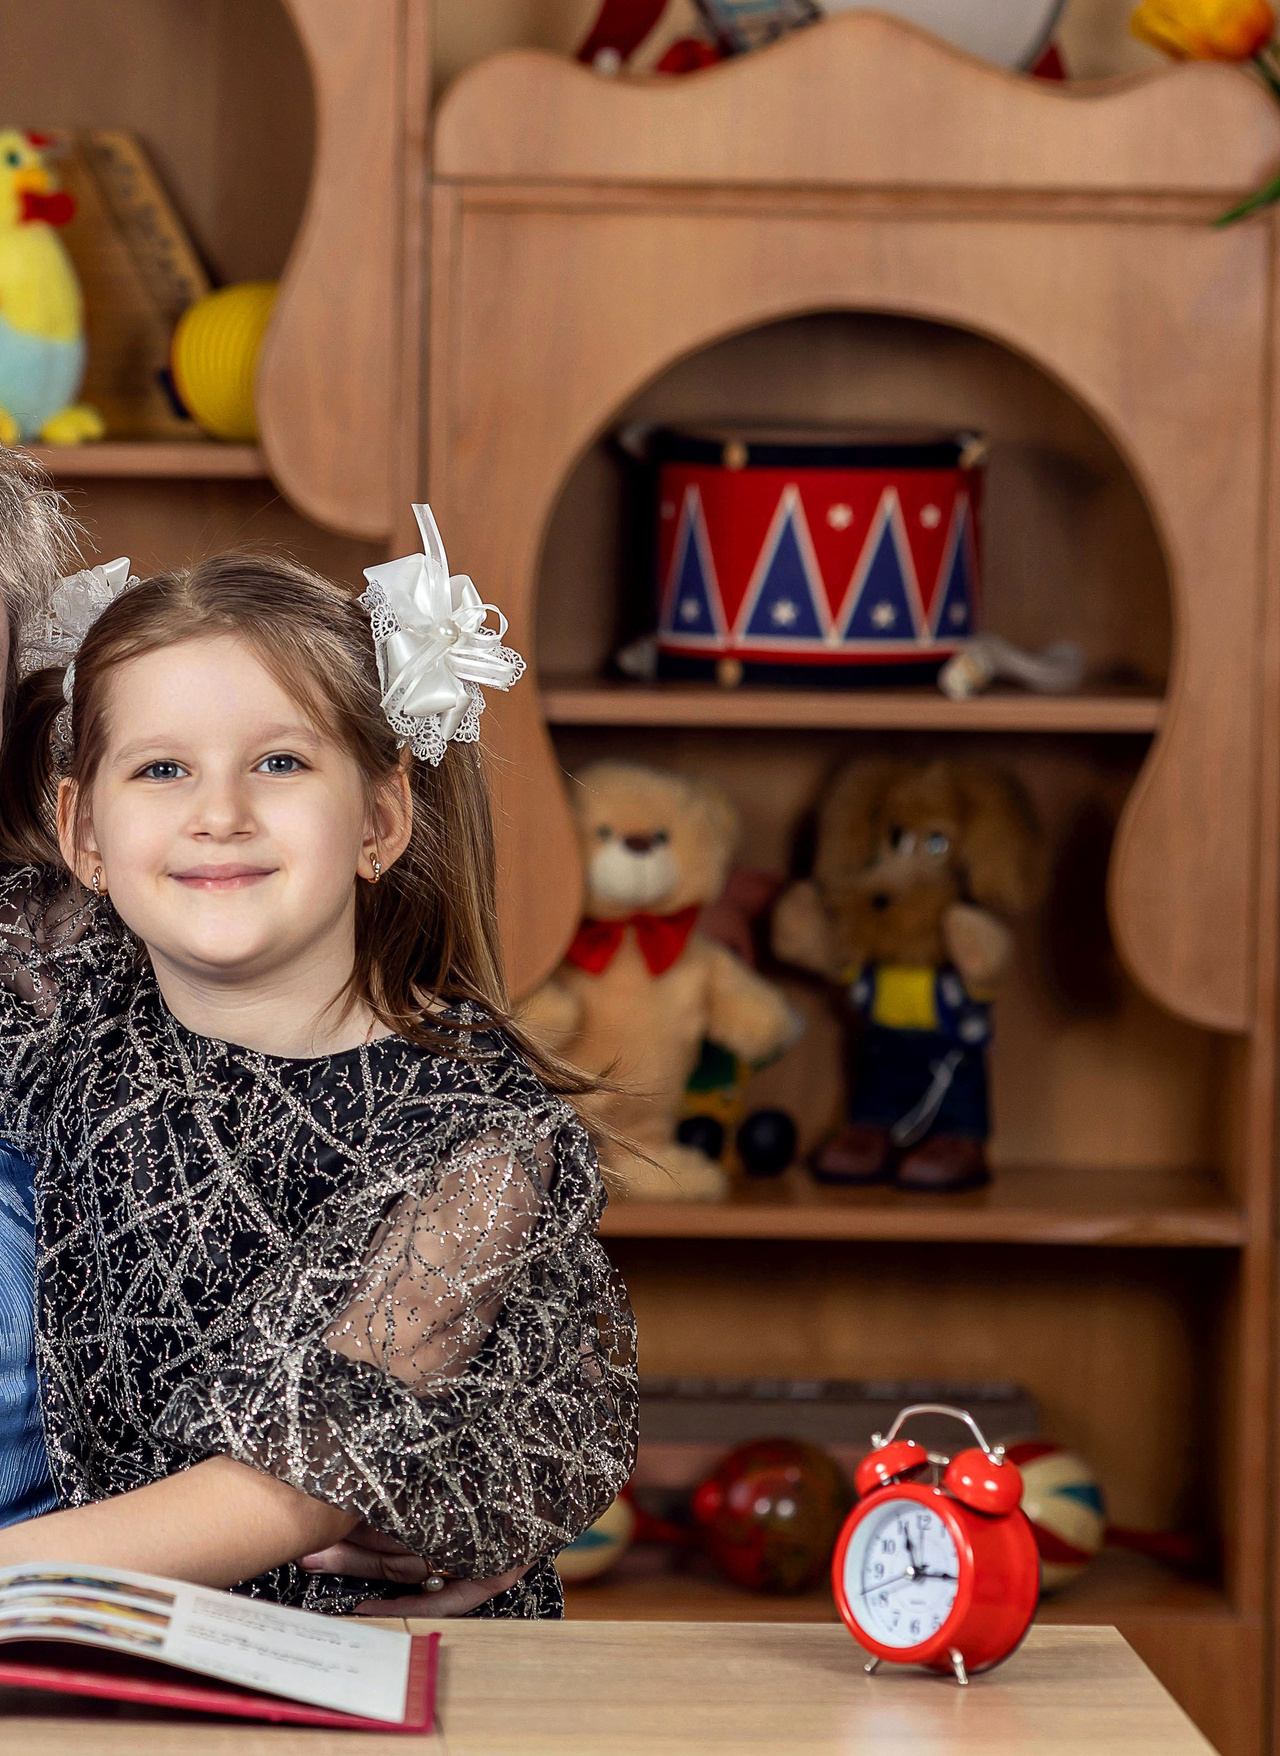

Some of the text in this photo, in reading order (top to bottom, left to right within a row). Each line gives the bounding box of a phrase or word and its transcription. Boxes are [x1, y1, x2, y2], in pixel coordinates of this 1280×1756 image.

[916, 1515, 932, 1530] 12
[882, 1540, 896, 1554] 10
[875, 1563, 884, 1578] 9
[879, 1591, 889, 1608] 8
[909, 1619, 920, 1635] 6
